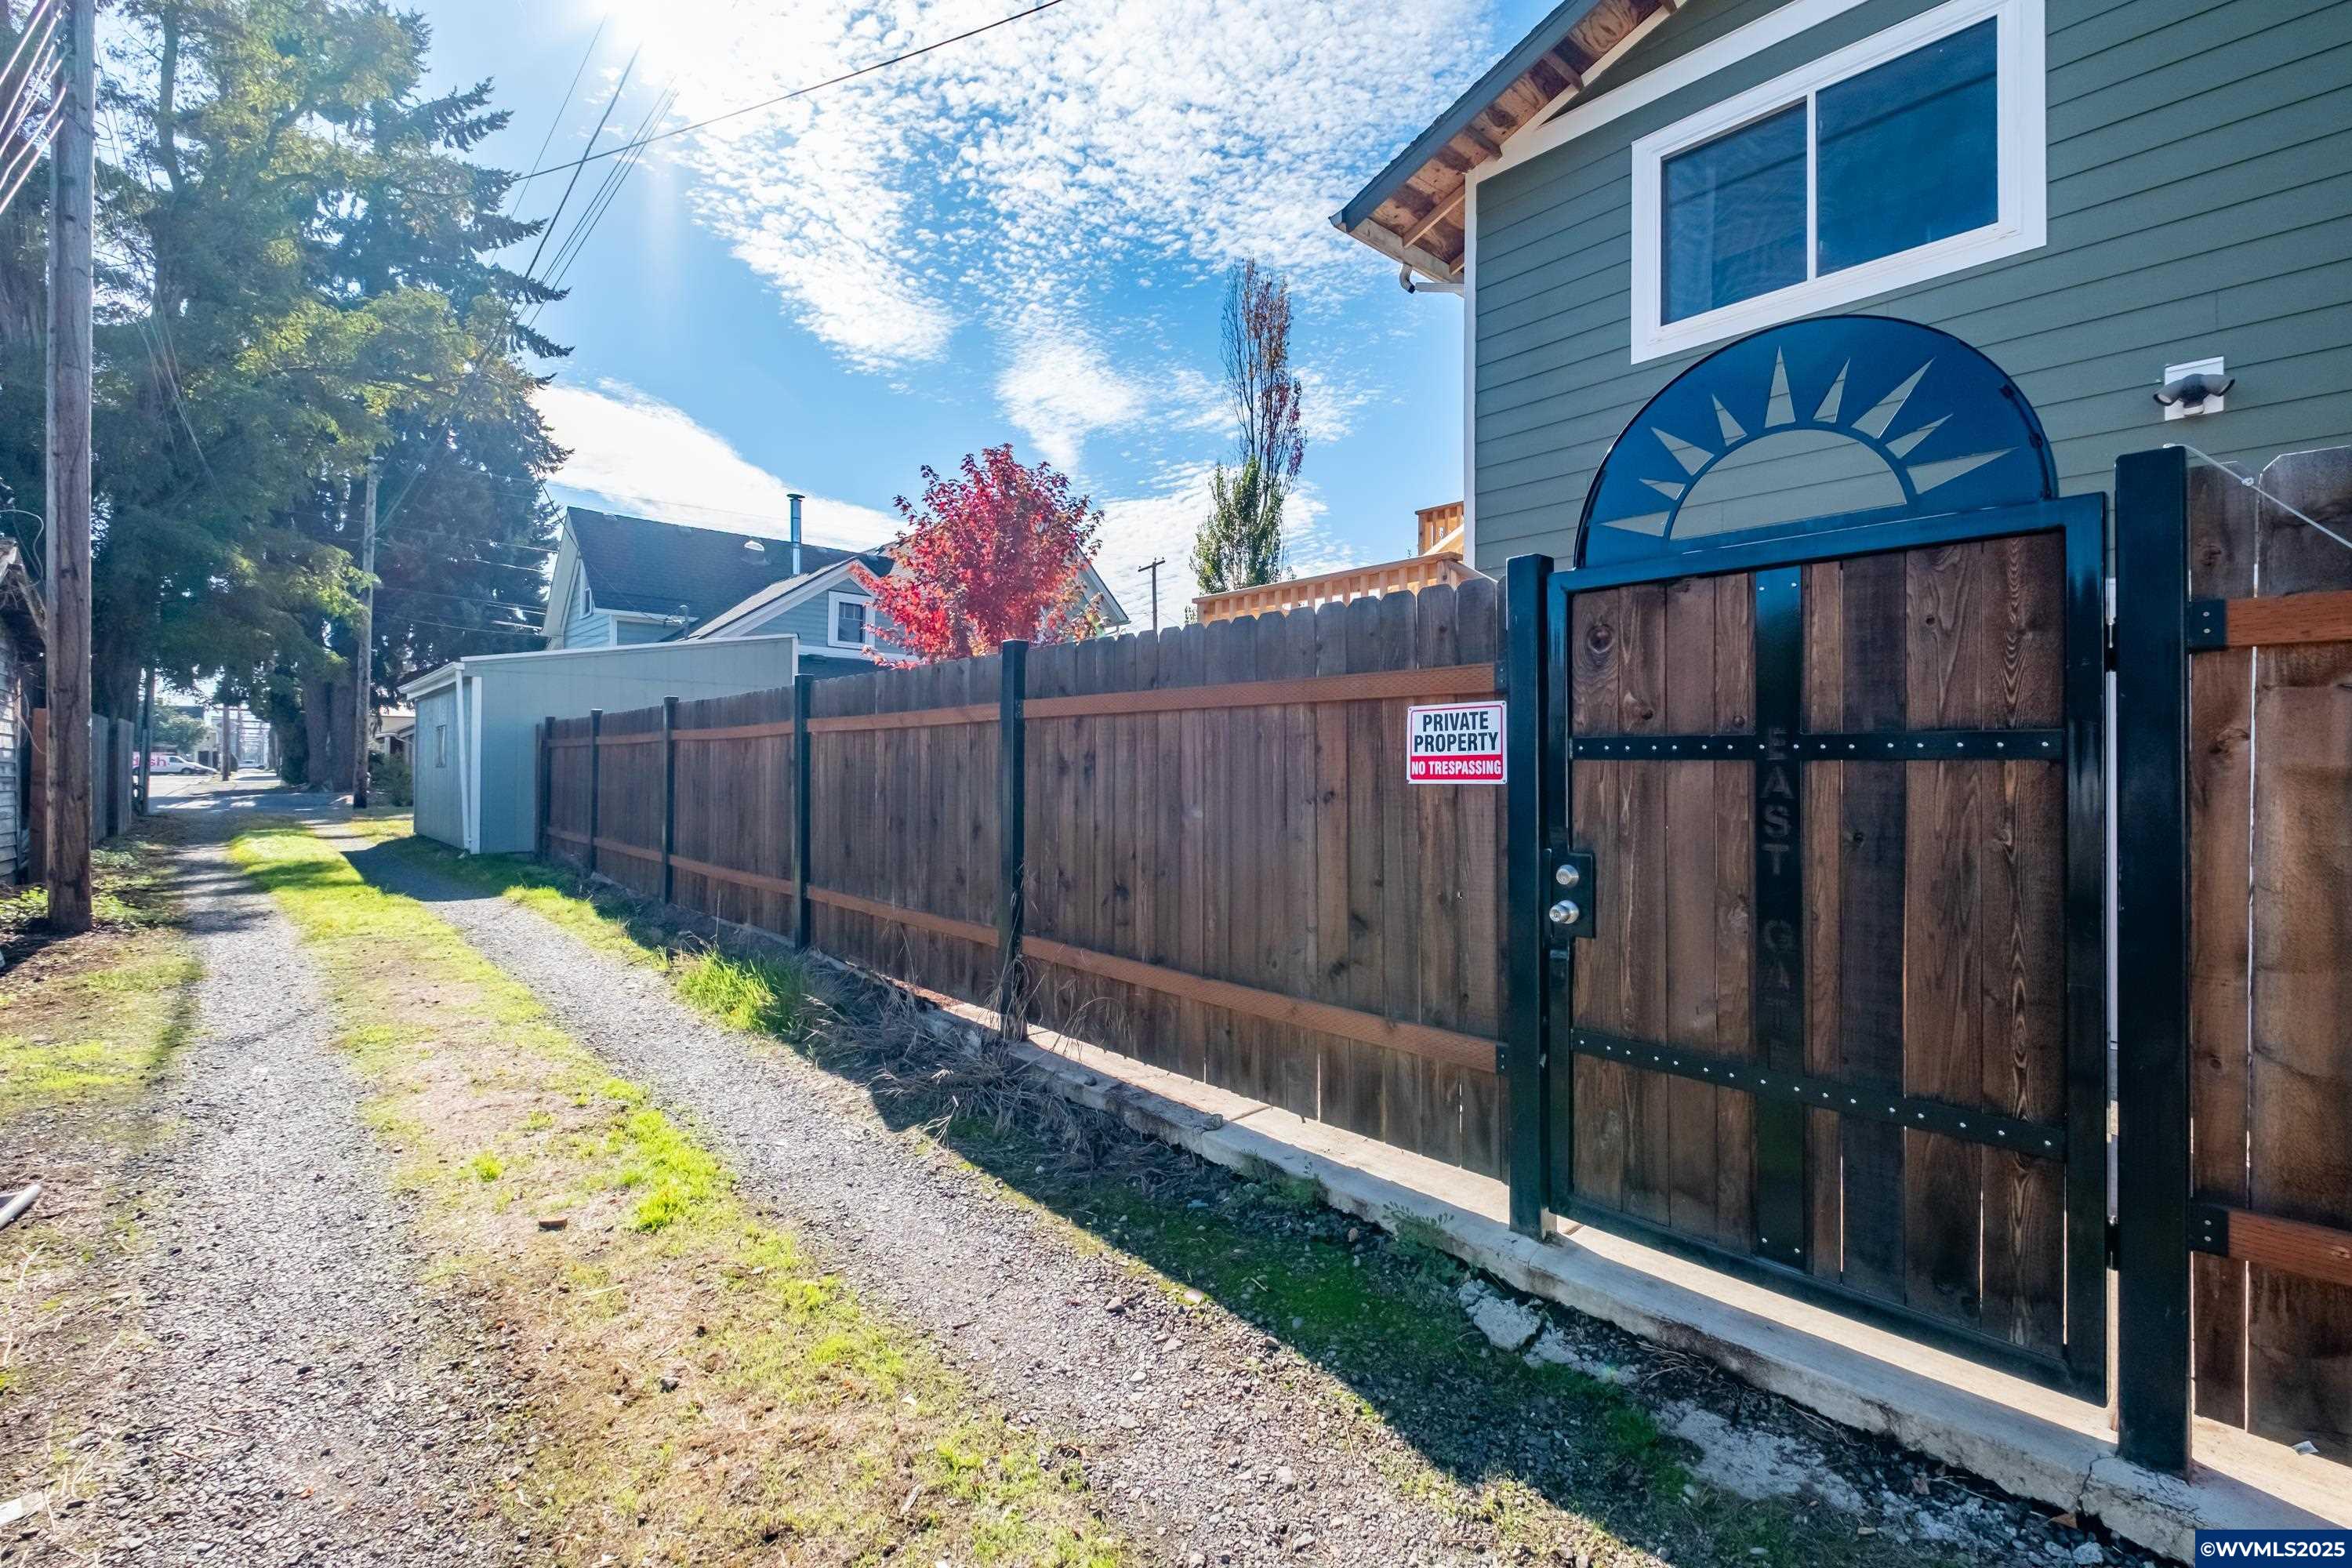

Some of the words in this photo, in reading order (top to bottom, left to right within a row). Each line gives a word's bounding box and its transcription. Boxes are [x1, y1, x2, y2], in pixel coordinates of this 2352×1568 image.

[1422, 710, 1489, 732] PRIVATE
[1414, 731, 1498, 753] PROPERTY
[1411, 761, 1425, 775] NO
[1428, 760, 1501, 775] TRESPASSING
[1760, 726, 1795, 876] EAST
